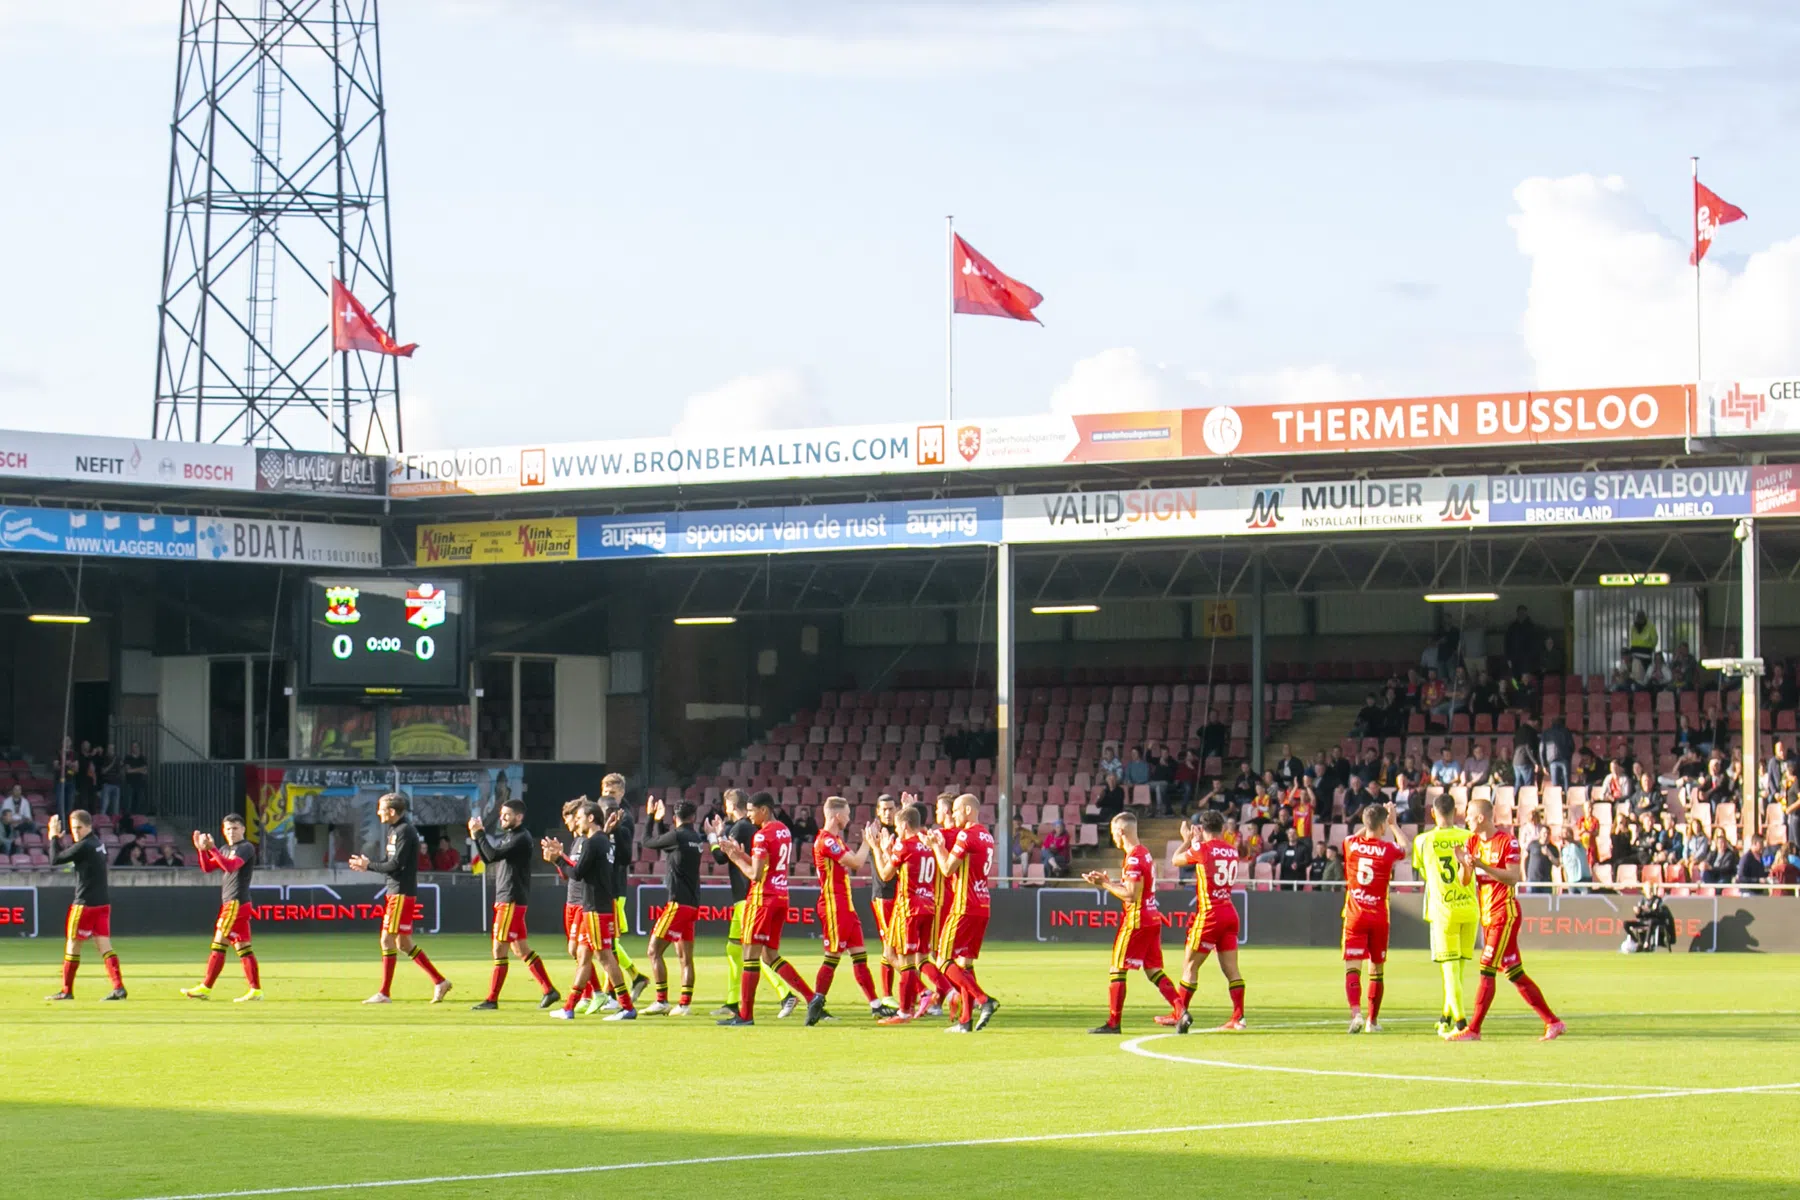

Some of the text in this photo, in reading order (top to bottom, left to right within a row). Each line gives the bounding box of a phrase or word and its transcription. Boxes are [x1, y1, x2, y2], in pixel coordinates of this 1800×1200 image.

[1272, 393, 1659, 443] THERMEN BUSSLOO
[76, 456, 124, 474] NEFIT
[552, 437, 909, 477] WWW.BRONBEMALING.COM
[184, 463, 233, 481] BOSCH
[1756, 468, 1793, 490] DAG EN
[1302, 483, 1422, 510] MULDER
[1492, 470, 1748, 504] BUITING STAALBOUW
[1756, 481, 1789, 502] NACHT
[1043, 490, 1197, 525] VALIDSIGN
[1525, 502, 1713, 521] BROEKLAND ALMELO
[1756, 489, 1796, 514] SERVICE
[685, 513, 887, 550] sponsor van de rust
[906, 511, 977, 538] auping
[1302, 514, 1422, 526] INSTALLATIETECHNIEK
[233, 523, 304, 560] BDATA
[422, 529, 456, 547] Klink
[518, 524, 553, 542] Klink
[601, 524, 666, 550] auping
[65, 536, 195, 557] WWW.VLAGGEN.COM
[307, 548, 380, 564] ICT SOLUTIONS
[427, 543, 473, 561] Nijland
[523, 539, 571, 557] Nijland
[332, 634, 435, 660] 0 0:00 0
[1350, 847, 1387, 861] POUW
[918, 856, 936, 884] 10
[1214, 860, 1238, 886] 30
[1357, 863, 1375, 890] 5
